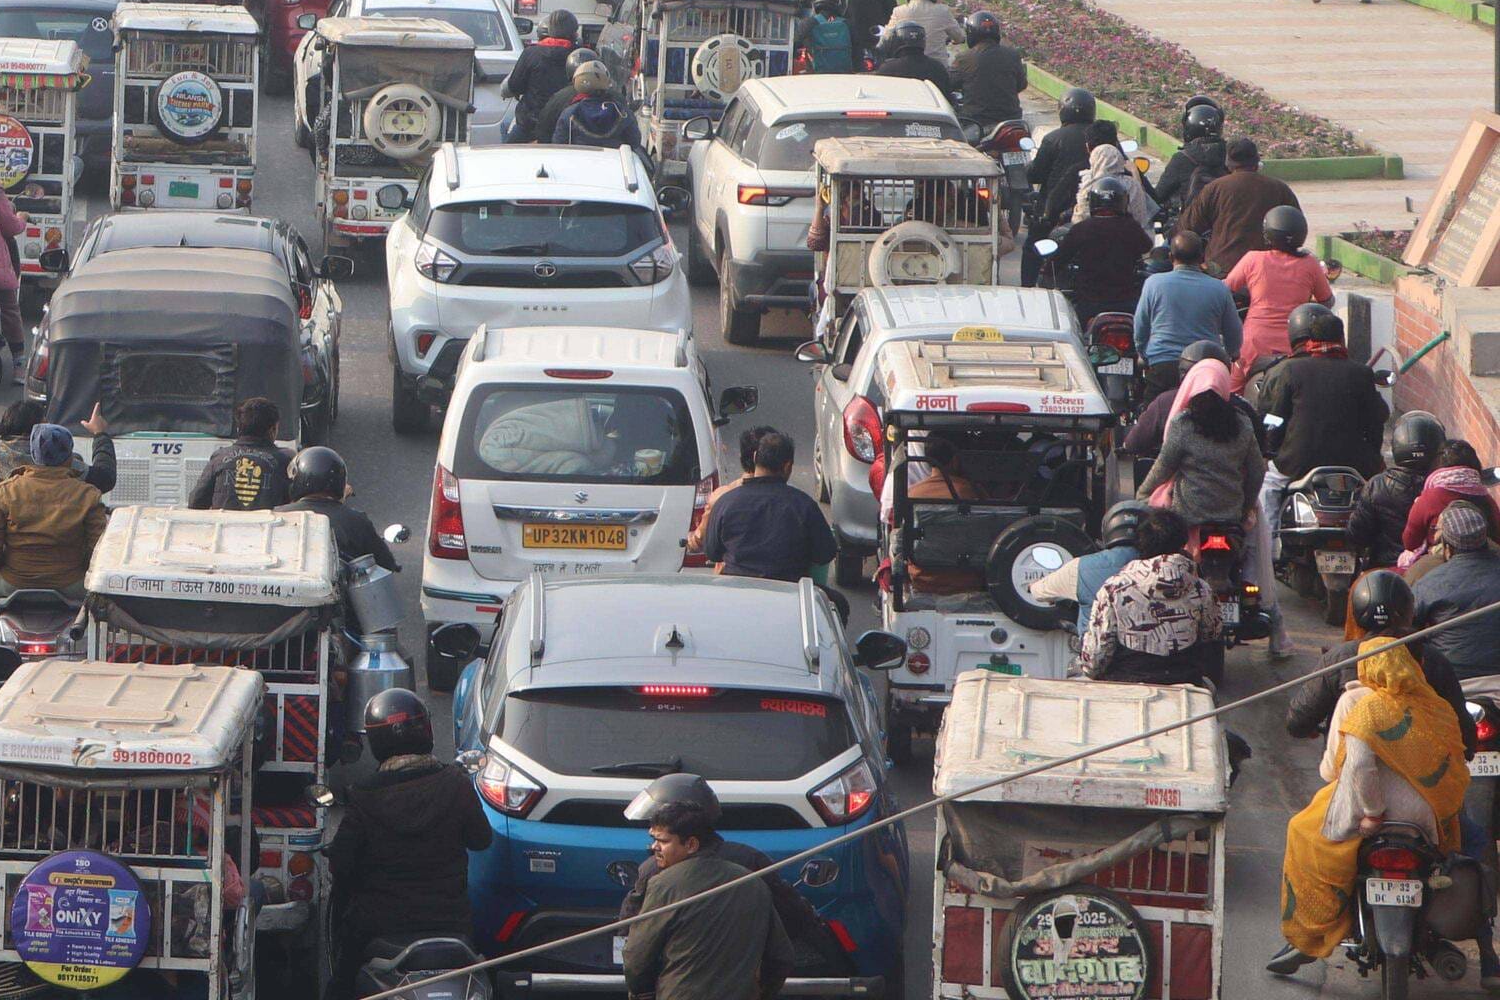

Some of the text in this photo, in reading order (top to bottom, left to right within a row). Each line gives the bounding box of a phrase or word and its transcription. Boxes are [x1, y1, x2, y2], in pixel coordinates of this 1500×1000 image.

[151, 443, 183, 454] TVS
[533, 527, 625, 545] UP32KN1048
[208, 580, 235, 594] 7800
[238, 583, 259, 595] 503
[260, 584, 282, 597] 444
